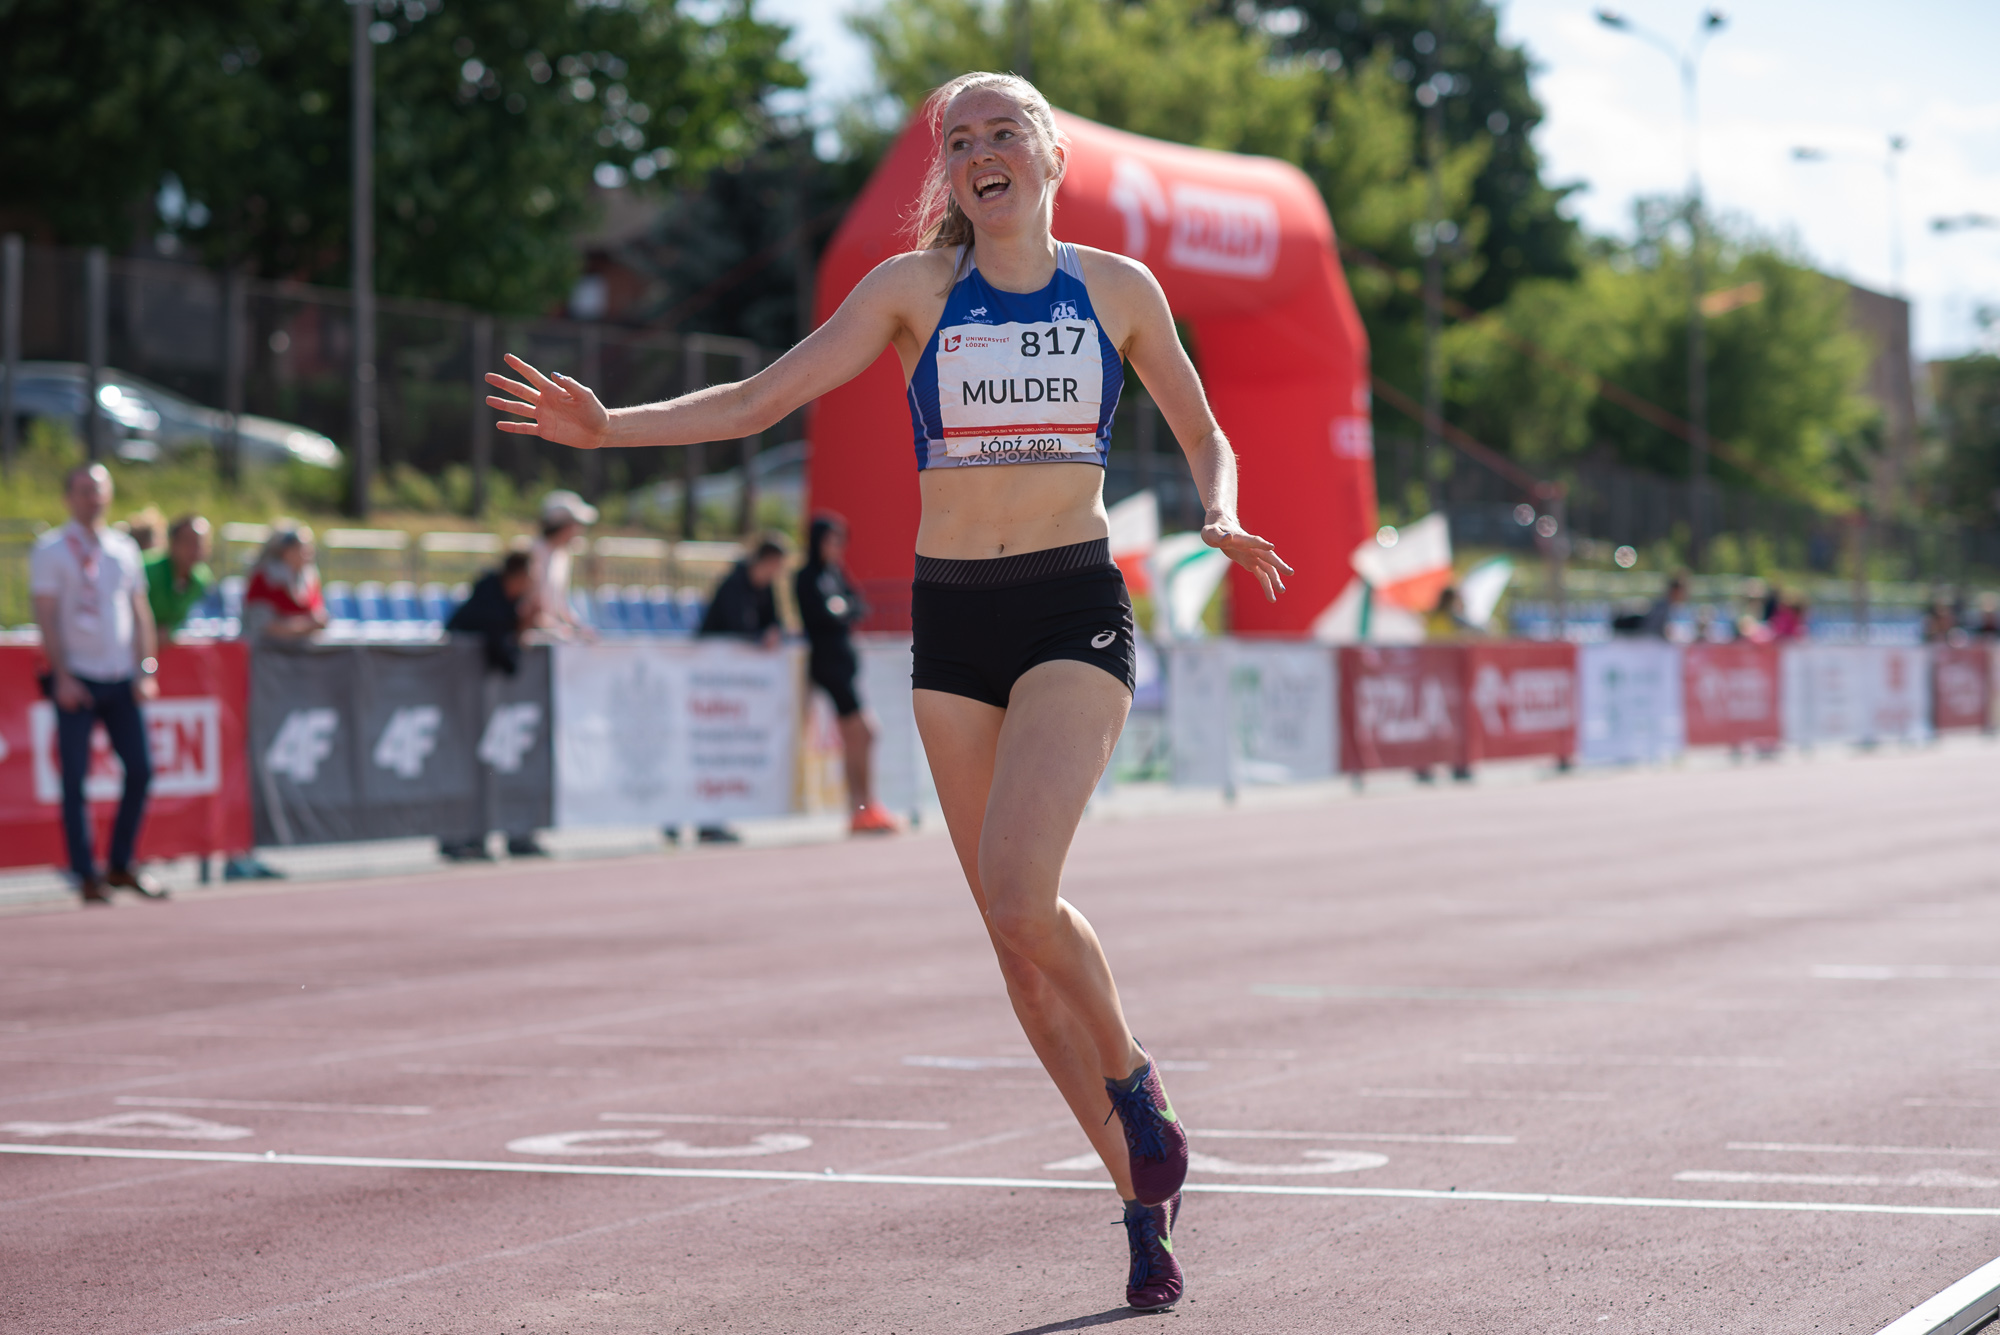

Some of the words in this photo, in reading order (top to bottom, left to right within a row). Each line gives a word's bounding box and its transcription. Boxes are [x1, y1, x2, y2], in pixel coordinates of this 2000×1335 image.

[965, 336, 1010, 344] UNIWERSYTET
[1020, 326, 1086, 357] 817
[962, 377, 1079, 406] MULDER
[958, 453, 990, 466] AZS
[979, 436, 1022, 454] ŁÓDŹ
[1027, 438, 1062, 452] 2021
[266, 708, 339, 783] 4F
[374, 705, 443, 780] 4F
[478, 702, 542, 774] 4F
